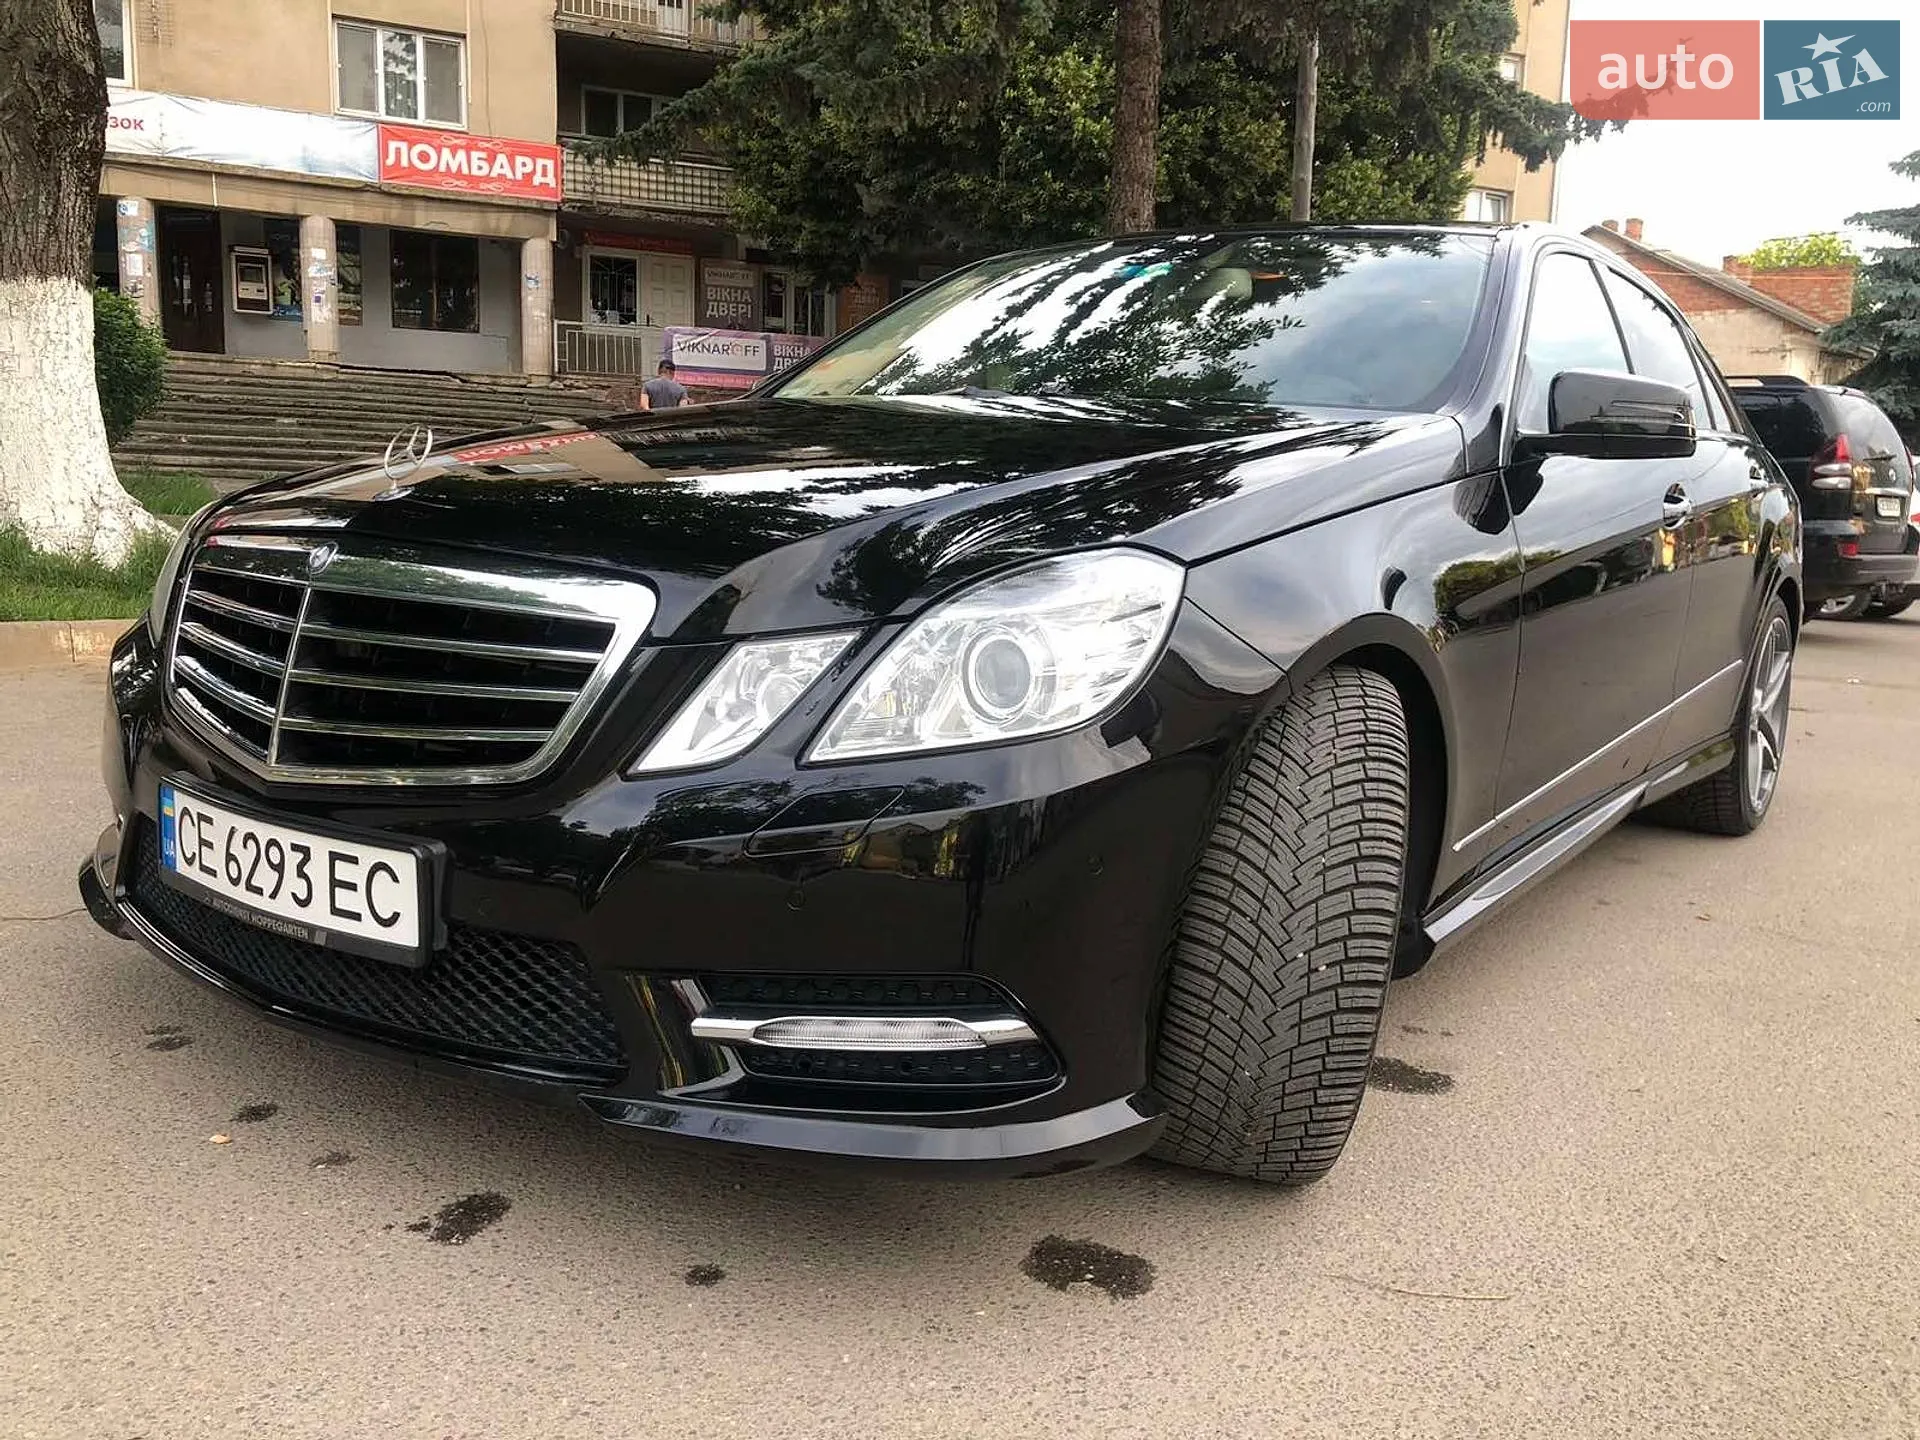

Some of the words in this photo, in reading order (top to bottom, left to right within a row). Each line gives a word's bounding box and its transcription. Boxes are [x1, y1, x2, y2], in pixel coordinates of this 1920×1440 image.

[385, 140, 556, 188] ЛОМБАРД
[706, 302, 752, 318] ДВЕРІ
[707, 287, 752, 302] ВІКНА
[179, 806, 218, 879] CE
[225, 825, 313, 908] 6293
[328, 850, 401, 928] EC
